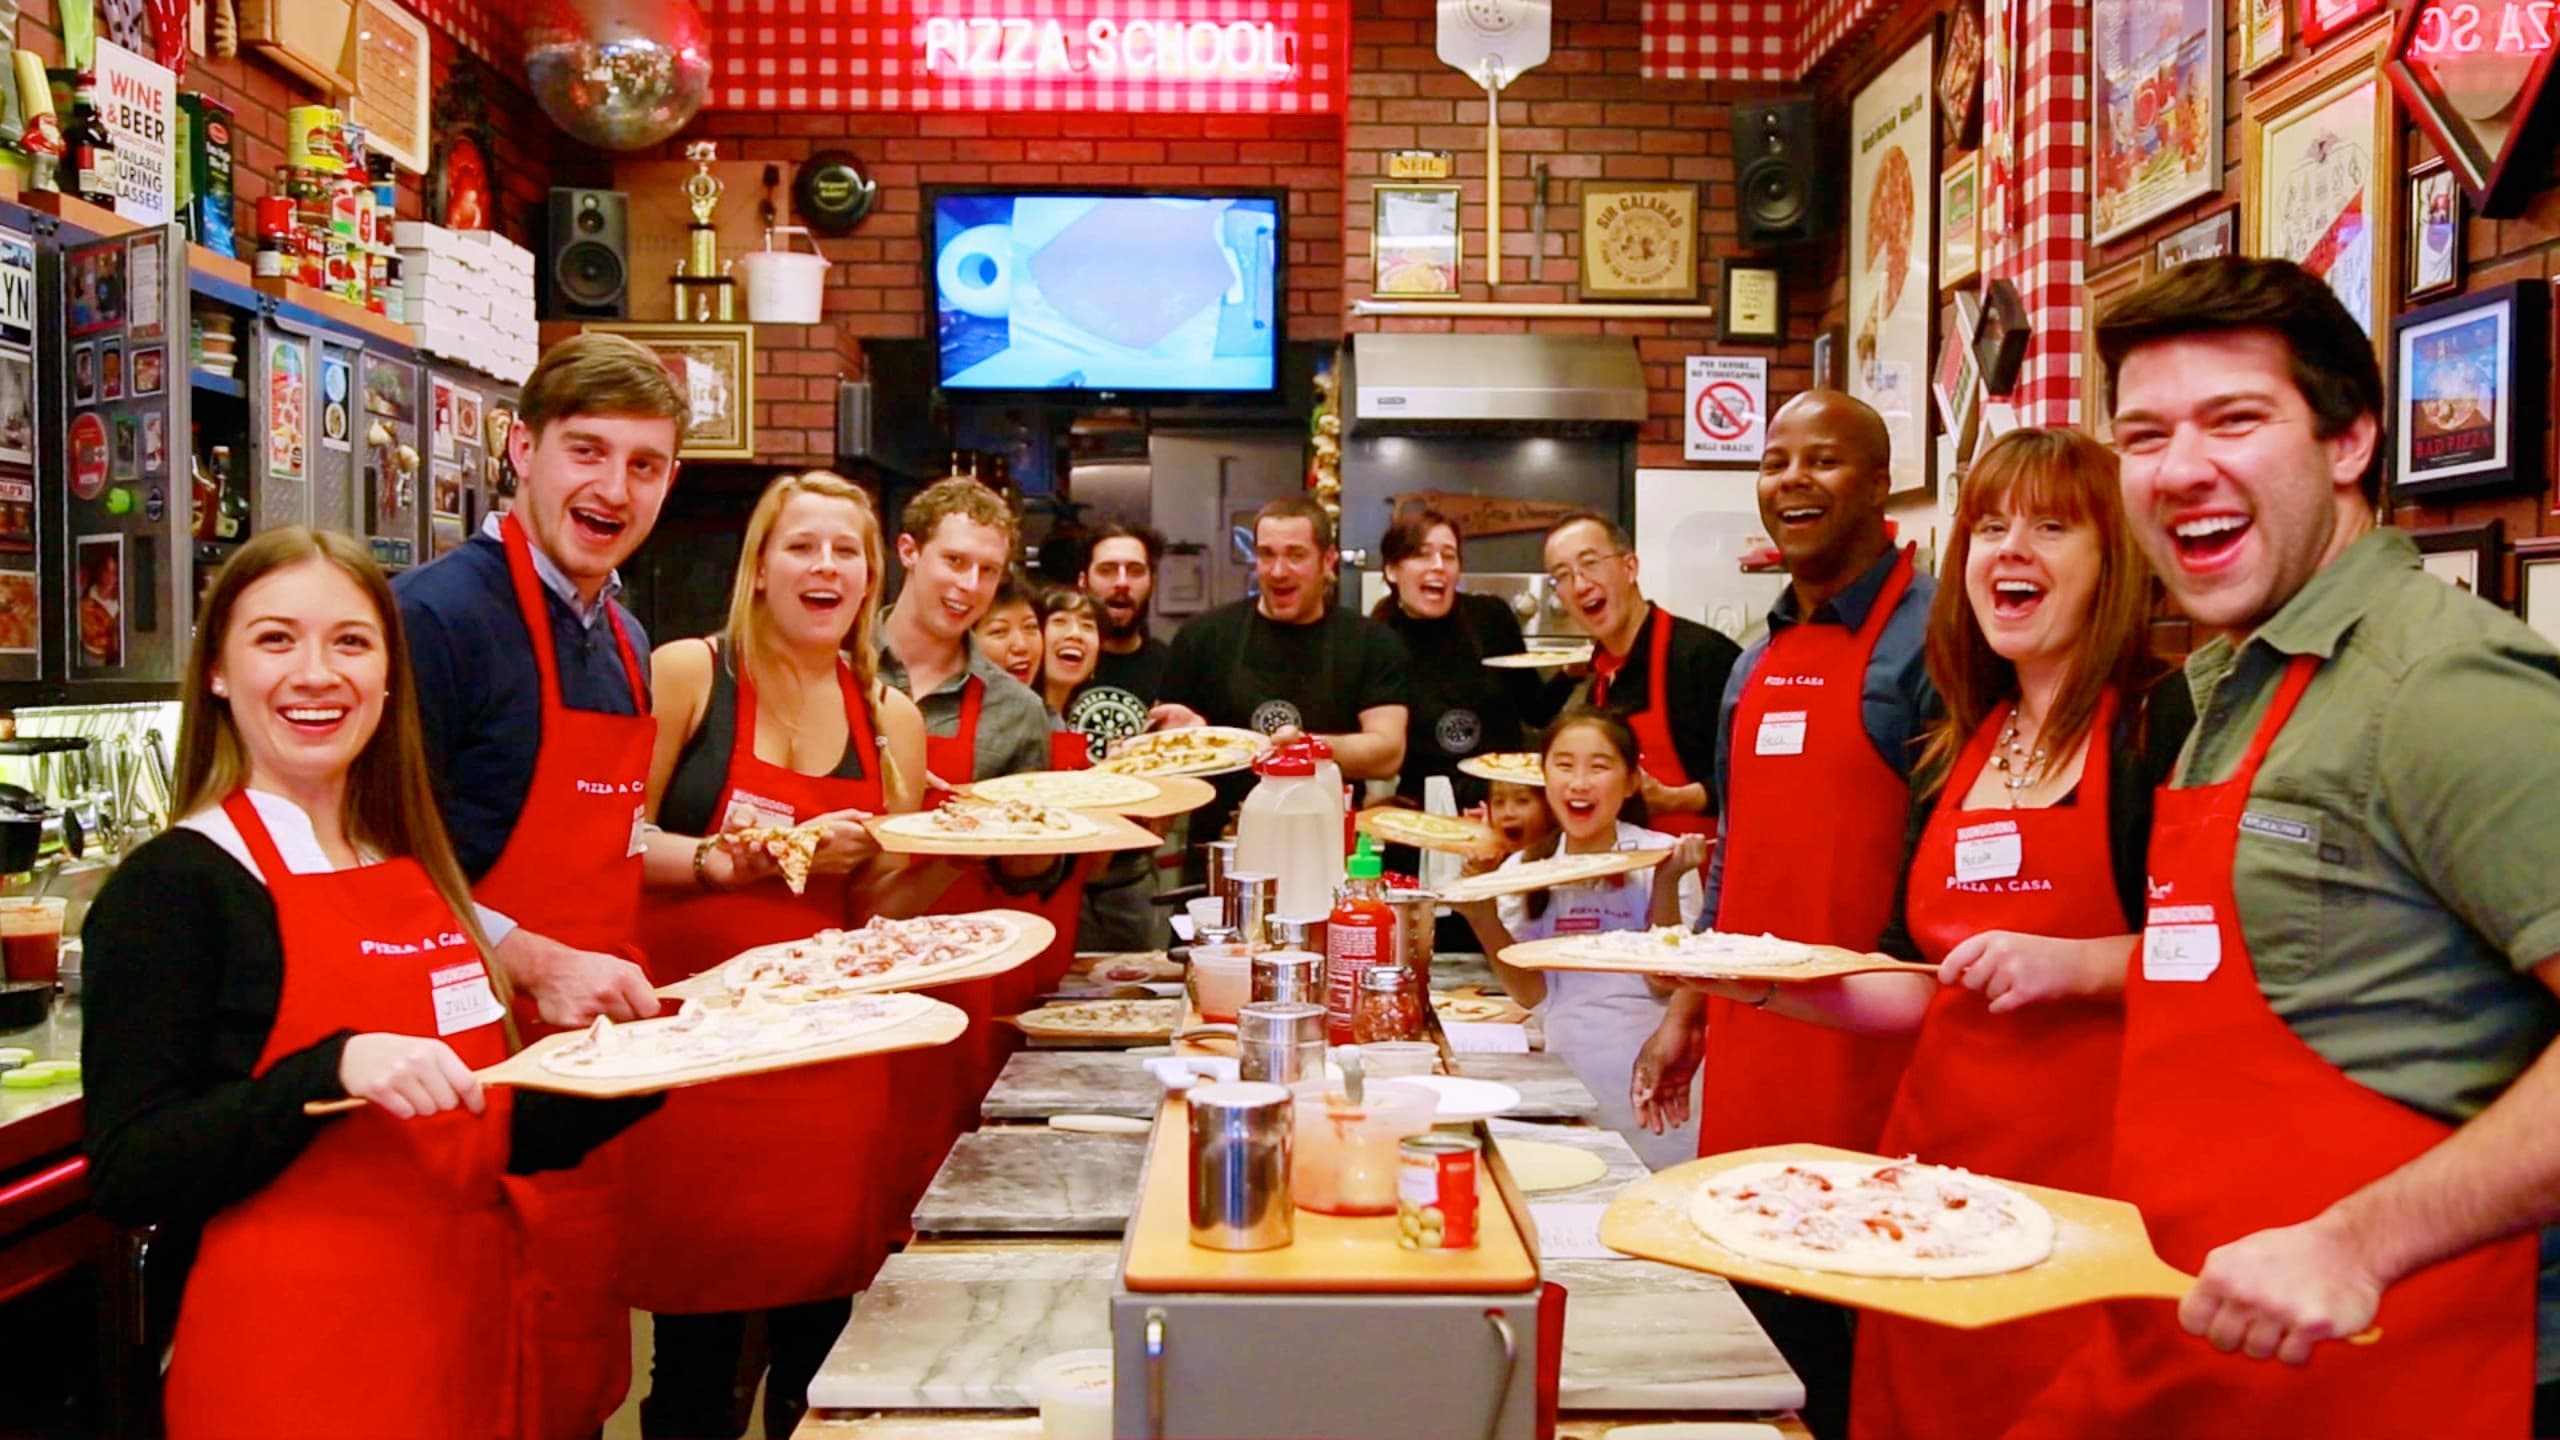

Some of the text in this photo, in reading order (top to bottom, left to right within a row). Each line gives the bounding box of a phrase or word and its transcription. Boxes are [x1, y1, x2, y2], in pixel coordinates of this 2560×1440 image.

[925, 17, 1291, 74] PIZZA SCHOOL
[110, 70, 163, 115] WINE
[115, 147, 163, 174] VAILABLE
[117, 161, 163, 193] URING
[115, 181, 163, 211] LASSES!
[1596, 195, 1683, 230] SIR GALAHAD
[0, 271, 30, 322] YN
[1795, 675, 1825, 686] CASA
[576, 779, 645, 794] PIZZA A C
[2007, 879, 2053, 892] CASA
[360, 939, 419, 955] PIZZA
[423, 937, 436, 950] A
